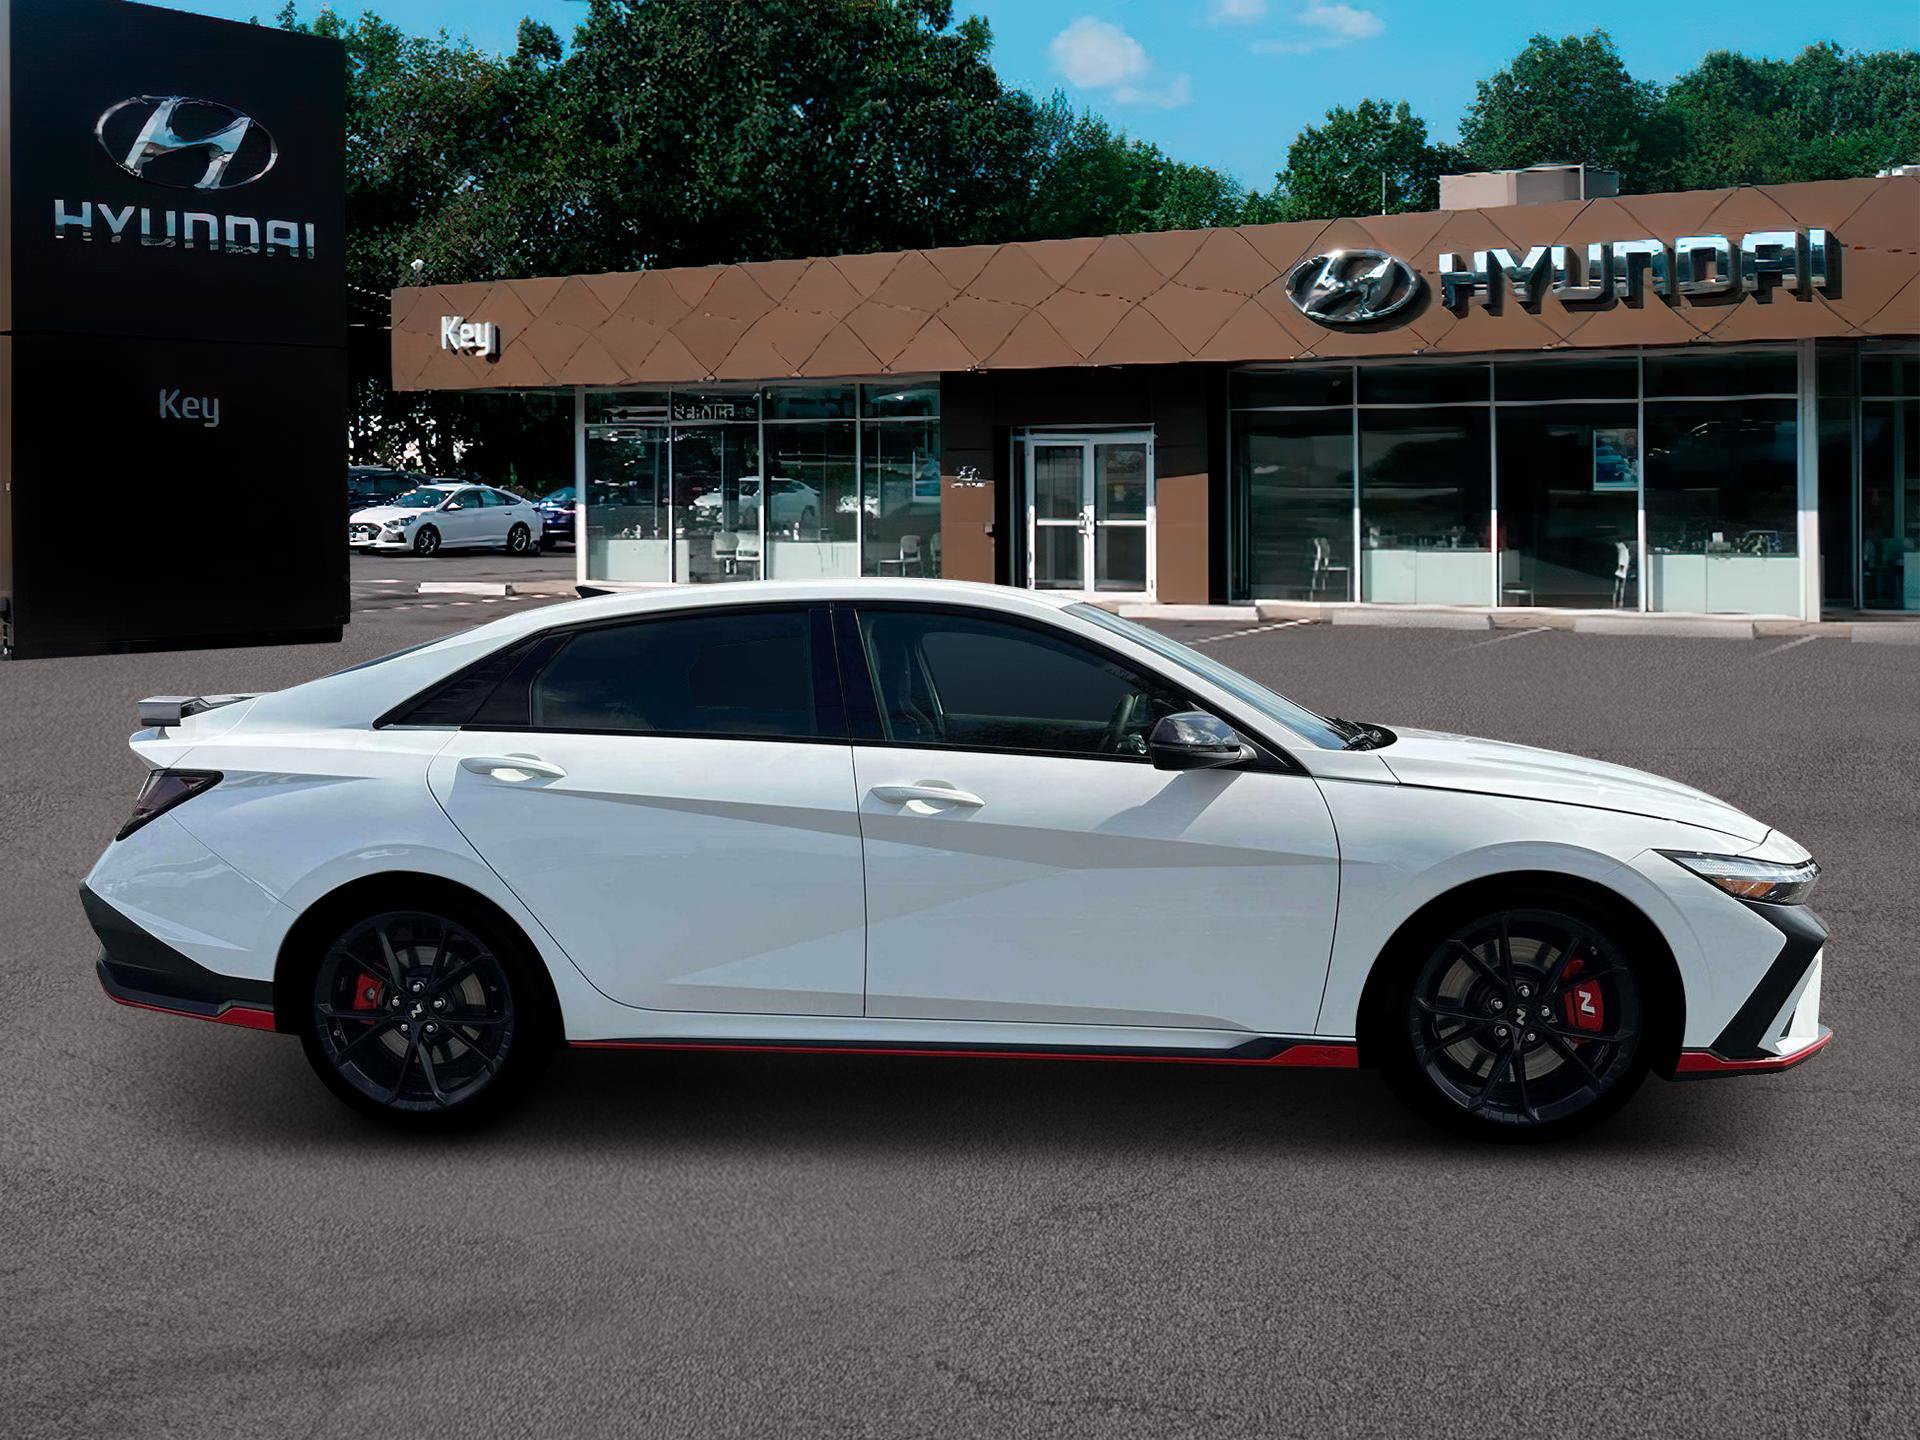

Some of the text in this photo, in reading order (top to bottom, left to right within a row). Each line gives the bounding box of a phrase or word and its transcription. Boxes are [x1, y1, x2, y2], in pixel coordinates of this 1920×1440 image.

[54, 199, 315, 260] HYUNDAI
[1438, 228, 1840, 314] HYUNDAI
[441, 315, 494, 357] Key
[159, 388, 220, 428] Key
